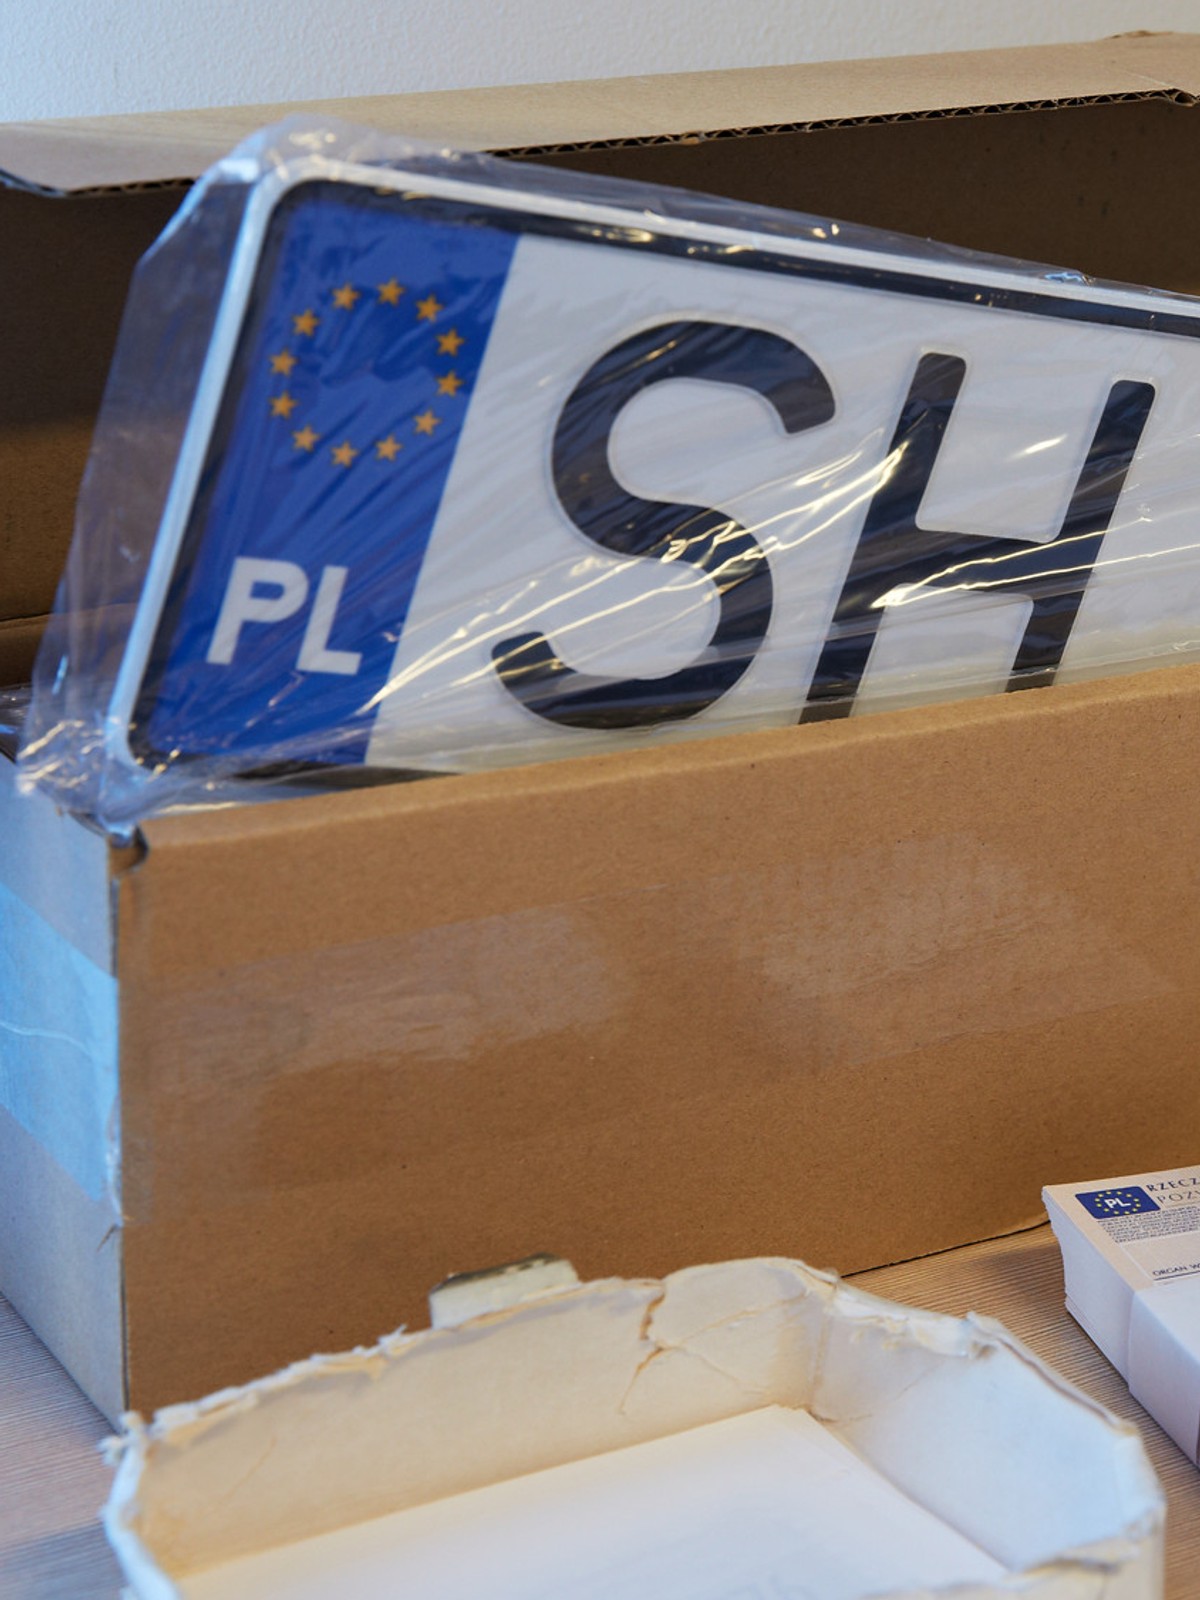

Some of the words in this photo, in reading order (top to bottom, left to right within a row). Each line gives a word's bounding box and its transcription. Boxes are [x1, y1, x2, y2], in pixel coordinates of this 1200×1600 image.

[491, 319, 1156, 730] SH
[204, 556, 364, 676] PL
[1104, 1197, 1131, 1209] PL
